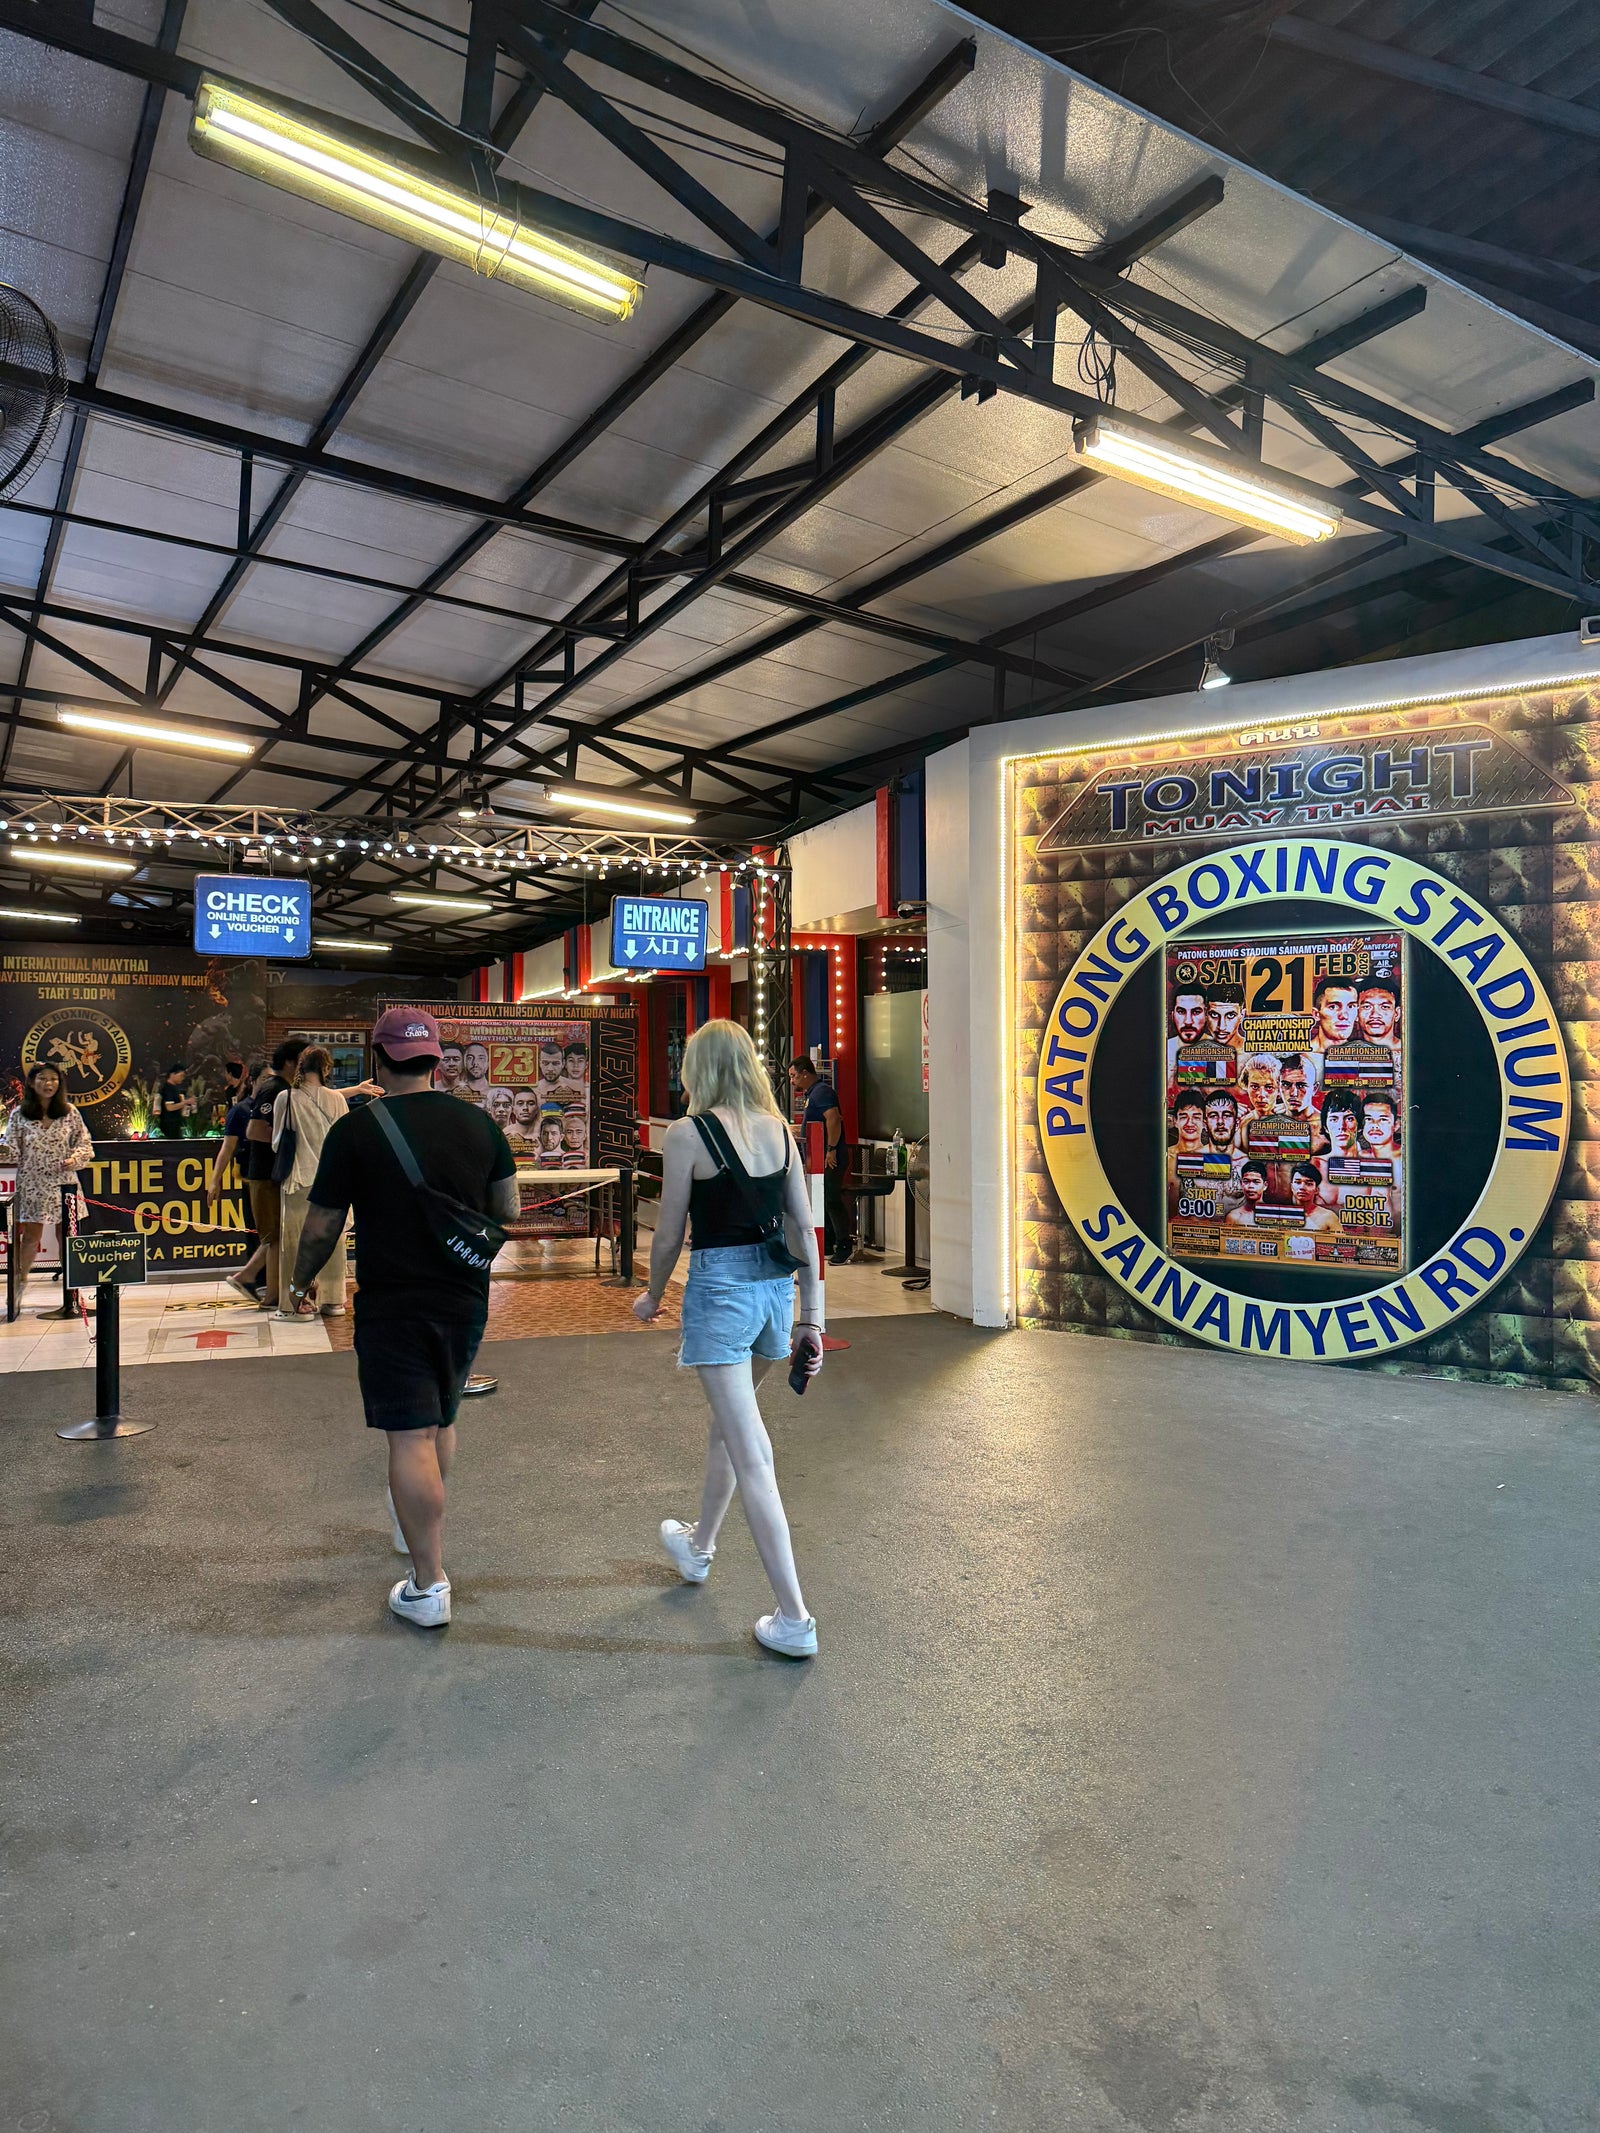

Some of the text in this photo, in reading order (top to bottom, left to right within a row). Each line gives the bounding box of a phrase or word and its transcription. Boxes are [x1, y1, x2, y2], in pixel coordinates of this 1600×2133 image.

[1096, 739, 1493, 832] TONIGHT
[1144, 794, 1429, 835] MUAY THAI
[206, 891, 300, 916] CHECK
[206, 912, 300, 925] ONLINE BOOKING
[623, 904, 700, 934] ENTRANCE
[227, 922, 280, 934] VOUCHER
[643, 936, 680, 955] 入口
[1177, 951, 1208, 960] PATONG
[1209, 948, 1239, 958] BOXING
[1240, 946, 1277, 957] STADIUM
[1278, 944, 1328, 955] SAINAMYEN
[3, 956, 149, 972] INTERNATIONAL MUAYTHAI
[111, 973, 131, 985] AND
[132, 973, 180, 986] SATURDAY
[181, 974, 209, 987] NIGHT
[1199, 952, 1370, 1013] SAT 21 FEB 2026
[38, 987, 116, 1000] START 9.00 PM
[1045, 846, 1564, 1153] PATONG BOXING STADIUM
[546, 1007, 564, 1018] AND
[565, 1008, 609, 1019] SATURDAY
[610, 1008, 636, 1019] NIGHT
[469, 1026, 520, 1036] MONDAY
[1243, 1018, 1314, 1031] CHAMPIONSHIP
[24, 1009, 128, 1064] PATONG BOXING STADIUM
[303, 1032, 360, 1044] FFICE
[1247, 1029, 1309, 1041] MUAY THAI
[1181, 1047, 1233, 1055] CHAMPIONSHIP
[1245, 1041, 1312, 1053] INTERNATIONAL
[1329, 1047, 1389, 1055] CHAMPIONSHIP
[493, 1047, 534, 1076] 23
[599, 1021, 636, 1120] NEXT
[1251, 1122, 1308, 1131] CHAMPIONSHIP
[85, 1159, 164, 1195] THE
[1187, 1188, 1217, 1200] START
[1179, 1198, 1225, 1218] 9:00 PM
[1345, 1195, 1386, 1211] DON'T
[1341, 1210, 1392, 1227] MISS IT.
[89, 1238, 141, 1250] WhatsApp
[78, 1250, 137, 1264] Voucher
[1081, 1203, 1526, 1357] SAINAMYEN RD.
